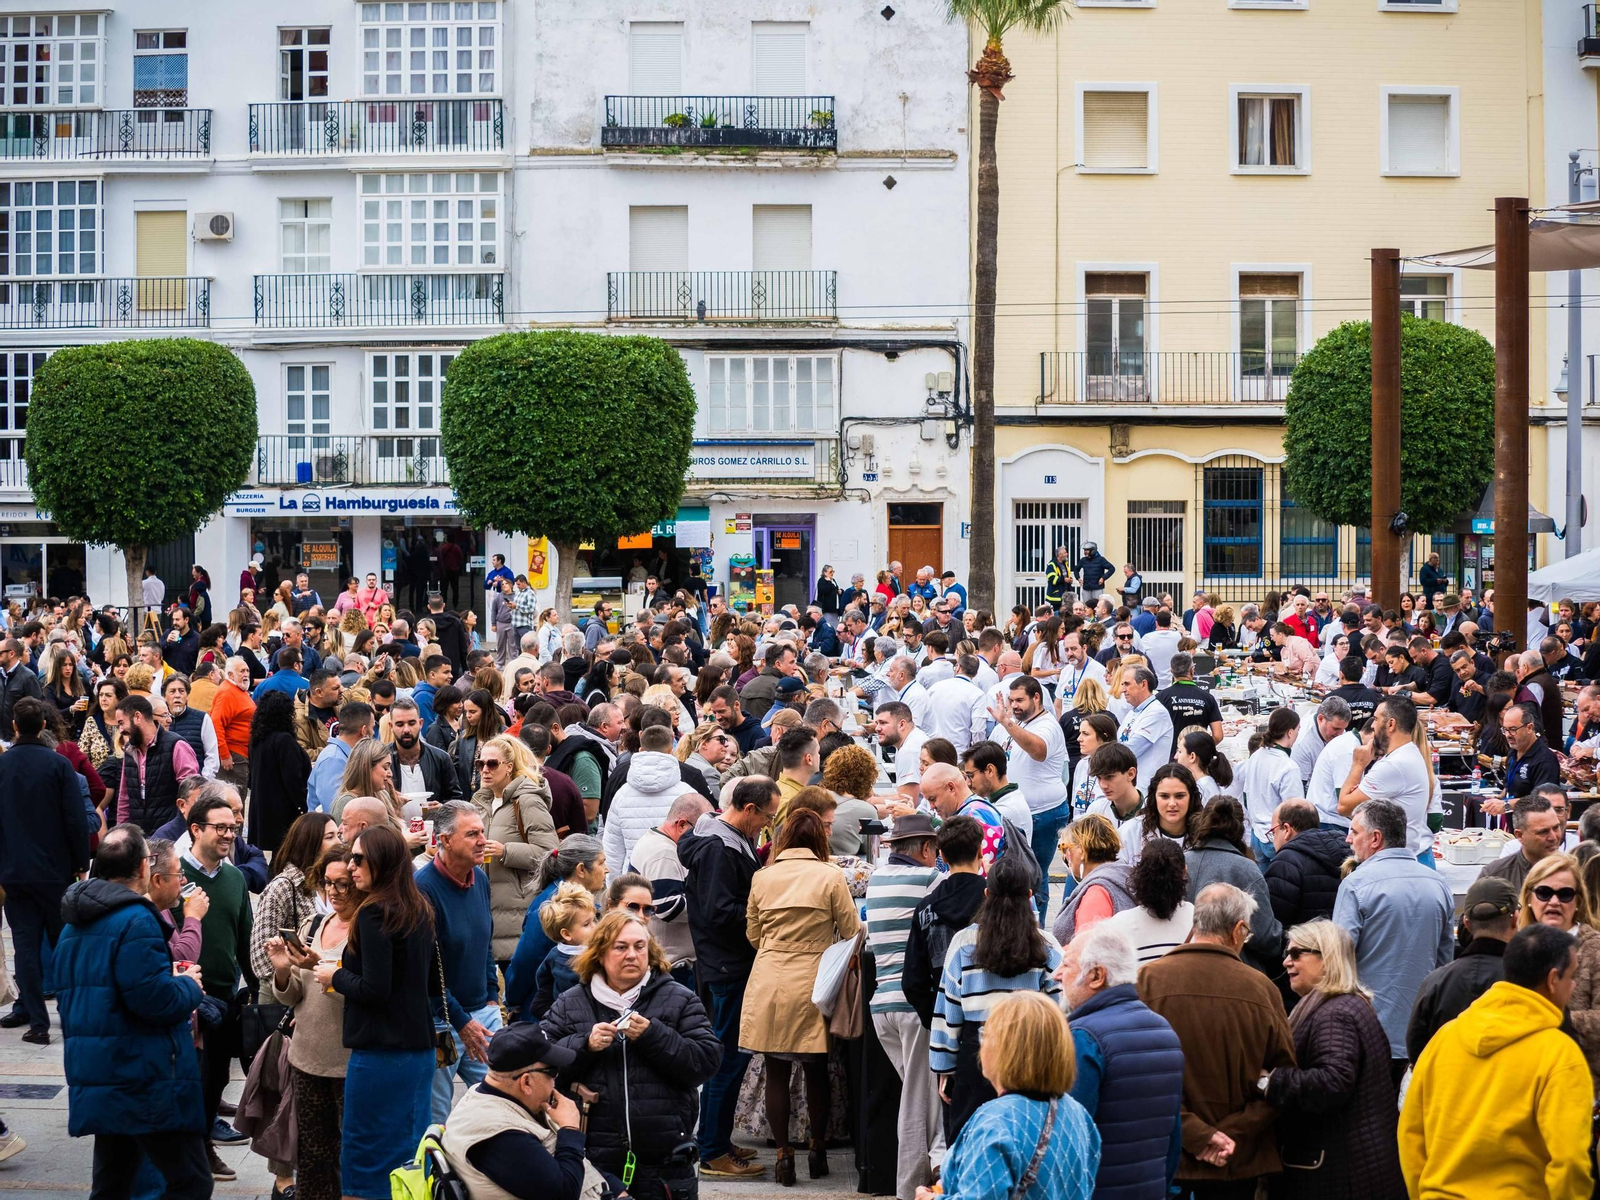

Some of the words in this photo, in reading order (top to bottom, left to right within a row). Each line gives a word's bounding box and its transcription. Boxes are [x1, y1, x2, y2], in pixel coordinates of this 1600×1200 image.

[718, 457, 748, 465] GOMEZ
[750, 457, 792, 465] CARRILLO
[794, 457, 810, 465] S.L.
[279, 496, 298, 509] La
[325, 495, 440, 512] Hamburguesía
[303, 544, 310, 552] SE
[312, 544, 337, 552] ALQUILA
